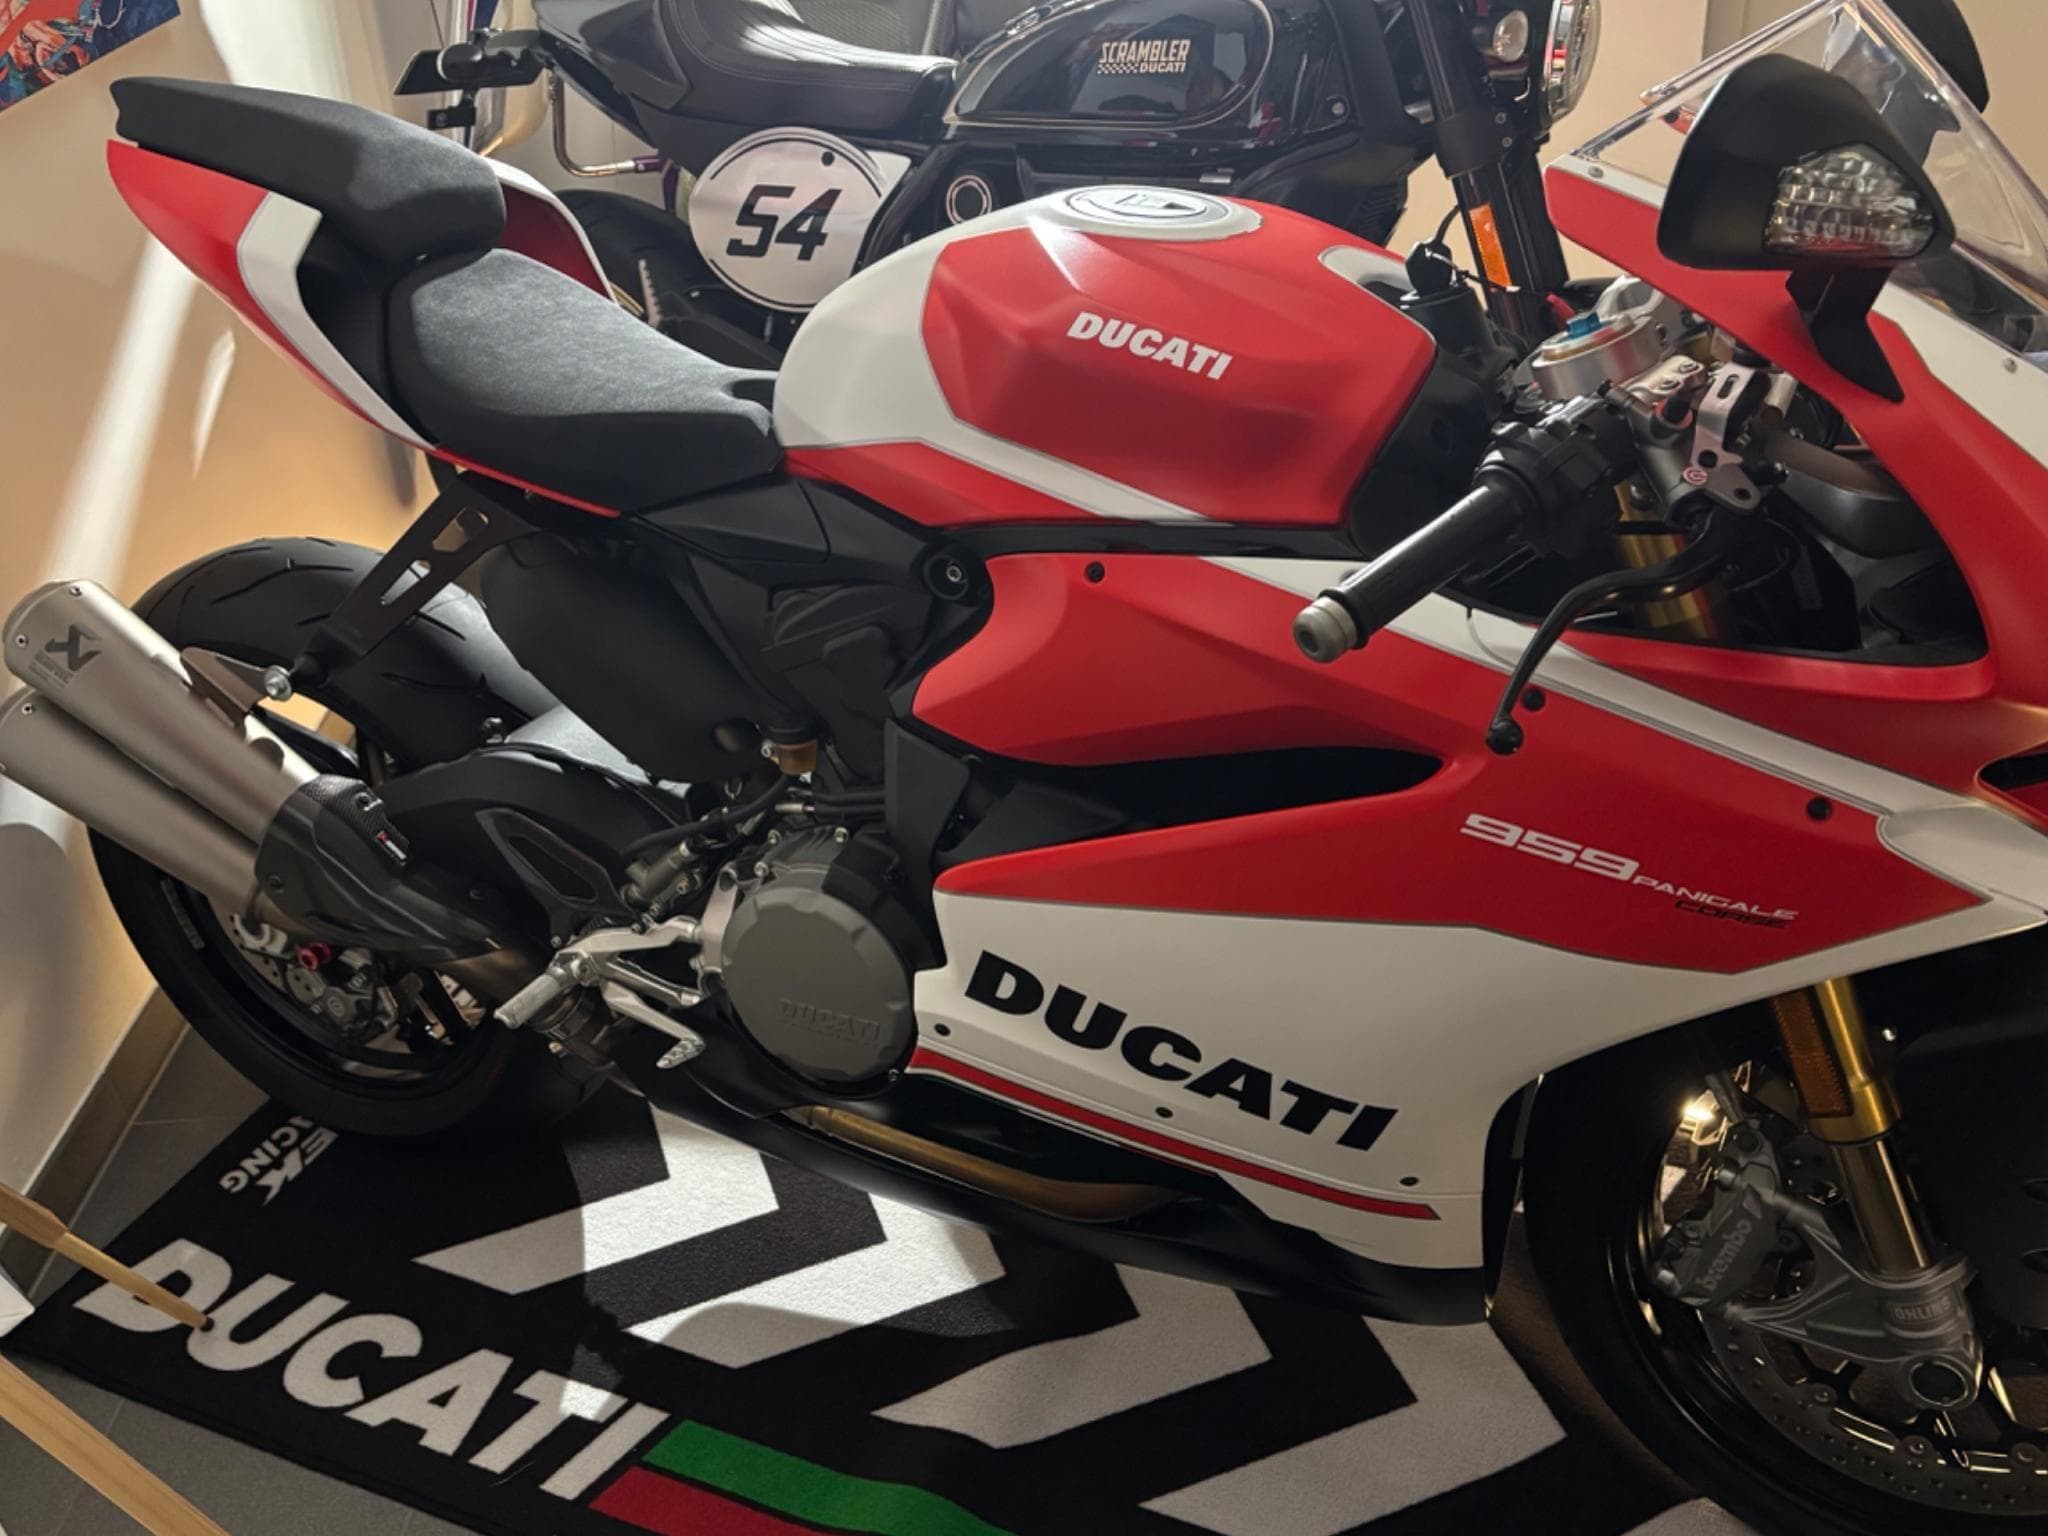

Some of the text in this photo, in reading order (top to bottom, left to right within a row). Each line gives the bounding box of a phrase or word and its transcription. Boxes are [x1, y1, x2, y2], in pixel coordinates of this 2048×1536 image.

[1099, 39, 1191, 63] SCRAMBLER
[1140, 61, 1186, 73] DUCATI
[726, 184, 842, 262] 54
[1066, 311, 1233, 380] DUCATI
[1460, 813, 1799, 921] 959 PANIGALE
[778, 997, 881, 1044] DUCATI
[965, 949, 1399, 1151] DUCATI
[1696, 1219, 1752, 1291] brembo
[74, 1238, 670, 1500] DUCATI
